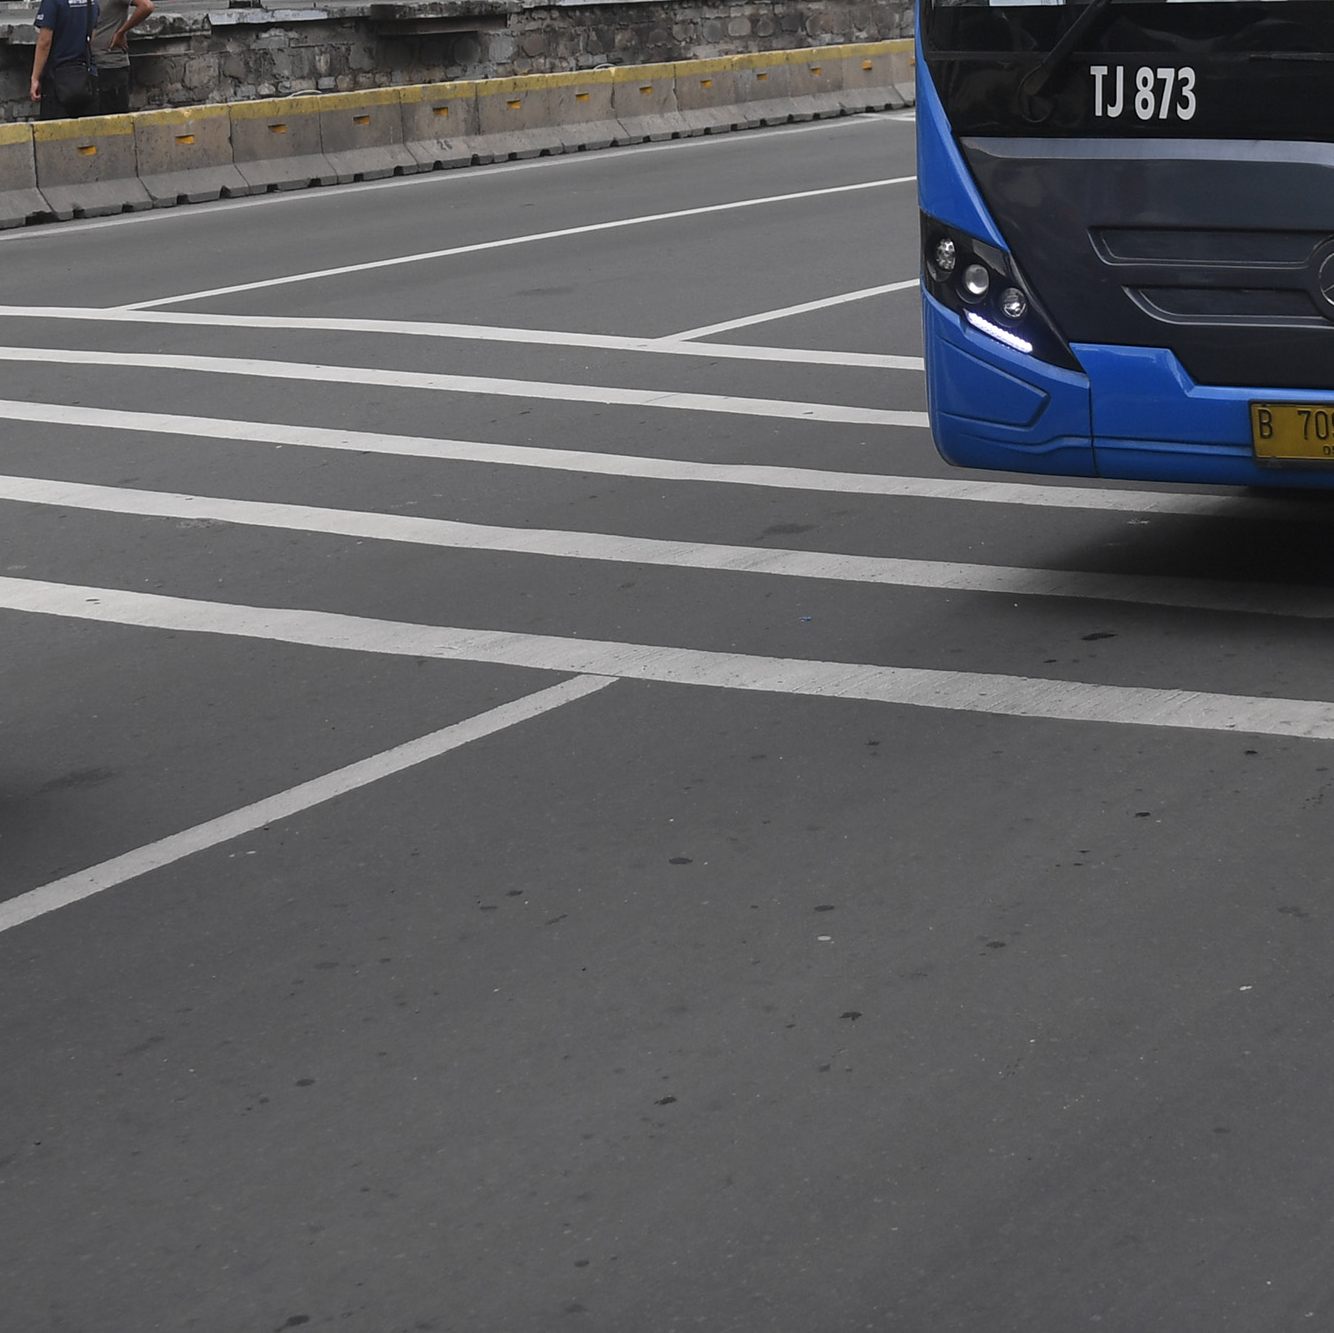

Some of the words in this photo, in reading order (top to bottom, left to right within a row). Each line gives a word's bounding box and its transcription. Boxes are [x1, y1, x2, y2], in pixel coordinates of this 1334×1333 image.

[1090, 65, 1124, 118] TJ
[1134, 66, 1197, 121] 873
[1257, 409, 1274, 439] B
